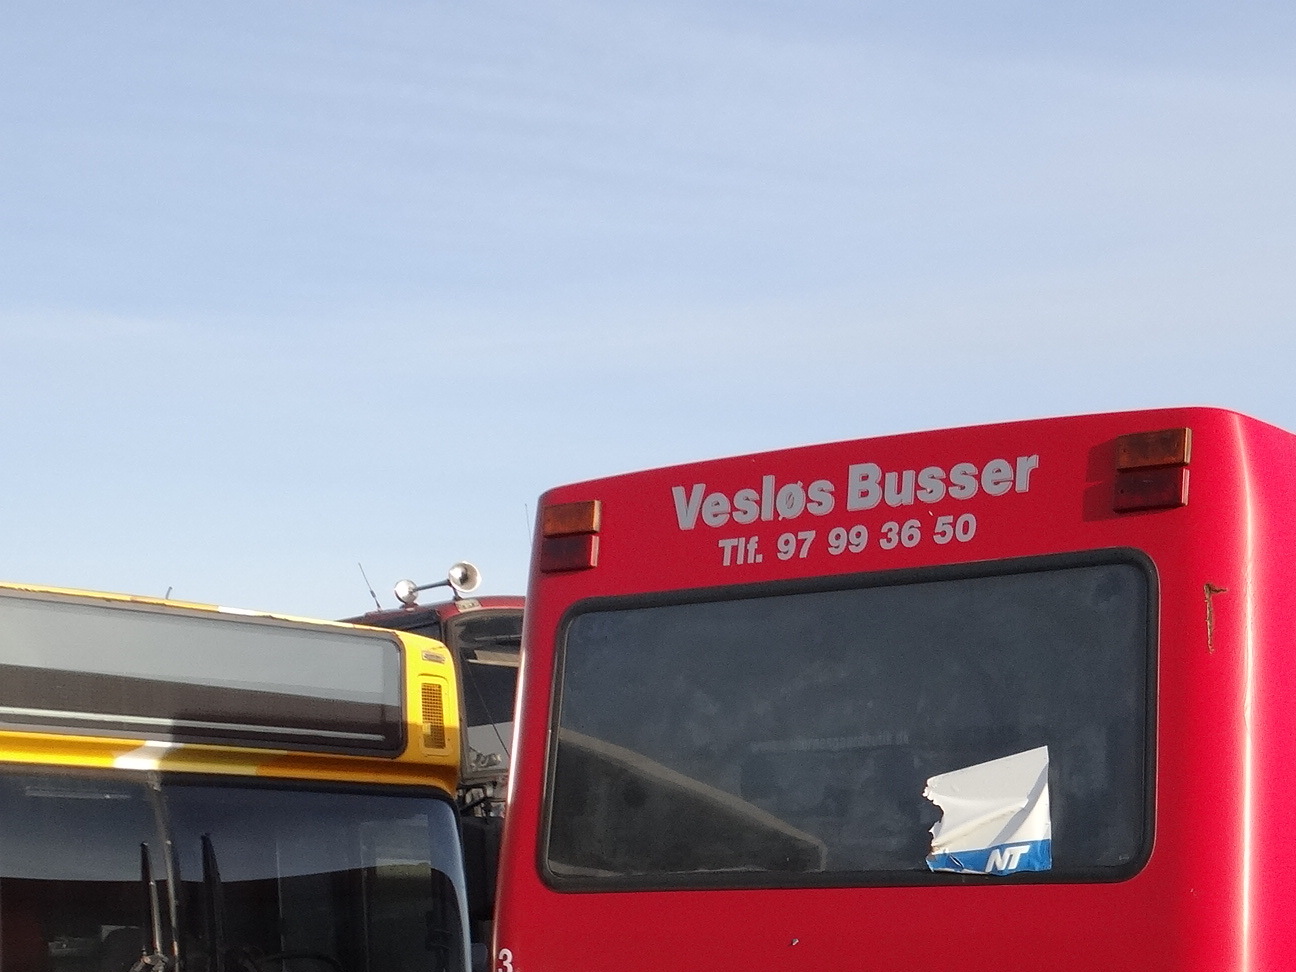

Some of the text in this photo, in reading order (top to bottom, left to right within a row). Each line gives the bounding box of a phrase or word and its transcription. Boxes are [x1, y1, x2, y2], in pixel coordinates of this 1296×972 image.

[671, 454, 1039, 531] Vesløs Busser
[717, 513, 977, 567] Tlf. 97 99 36 50
[985, 845, 1031, 873] NT
